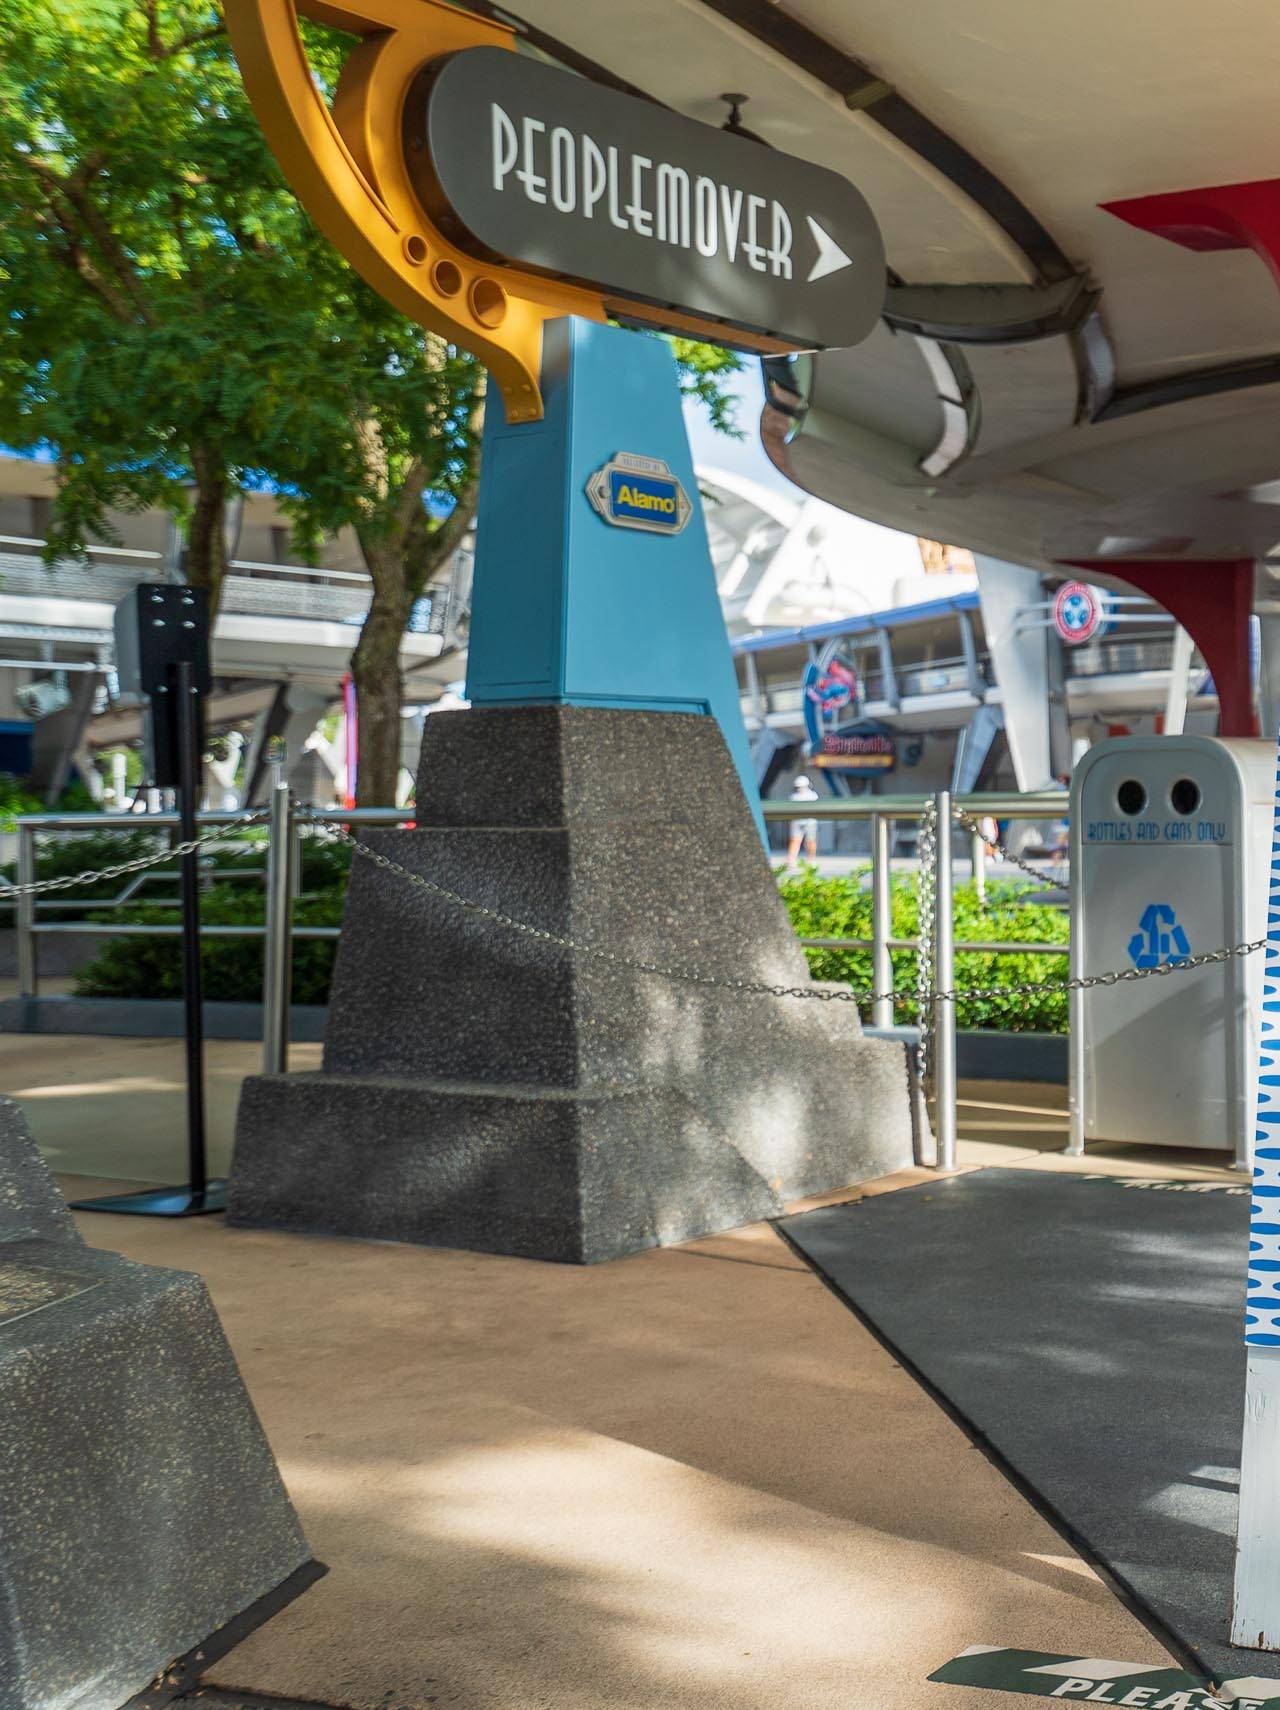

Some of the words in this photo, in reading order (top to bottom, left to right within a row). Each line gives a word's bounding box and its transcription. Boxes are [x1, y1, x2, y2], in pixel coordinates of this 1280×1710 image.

[491, 102, 793, 281] PEOPLEMOVER
[617, 484, 675, 514] Alamo
[1087, 822, 1133, 841] BOTTLES
[1135, 822, 1161, 840] AND
[1163, 822, 1193, 840] CANS
[1197, 821, 1226, 840] ONLY
